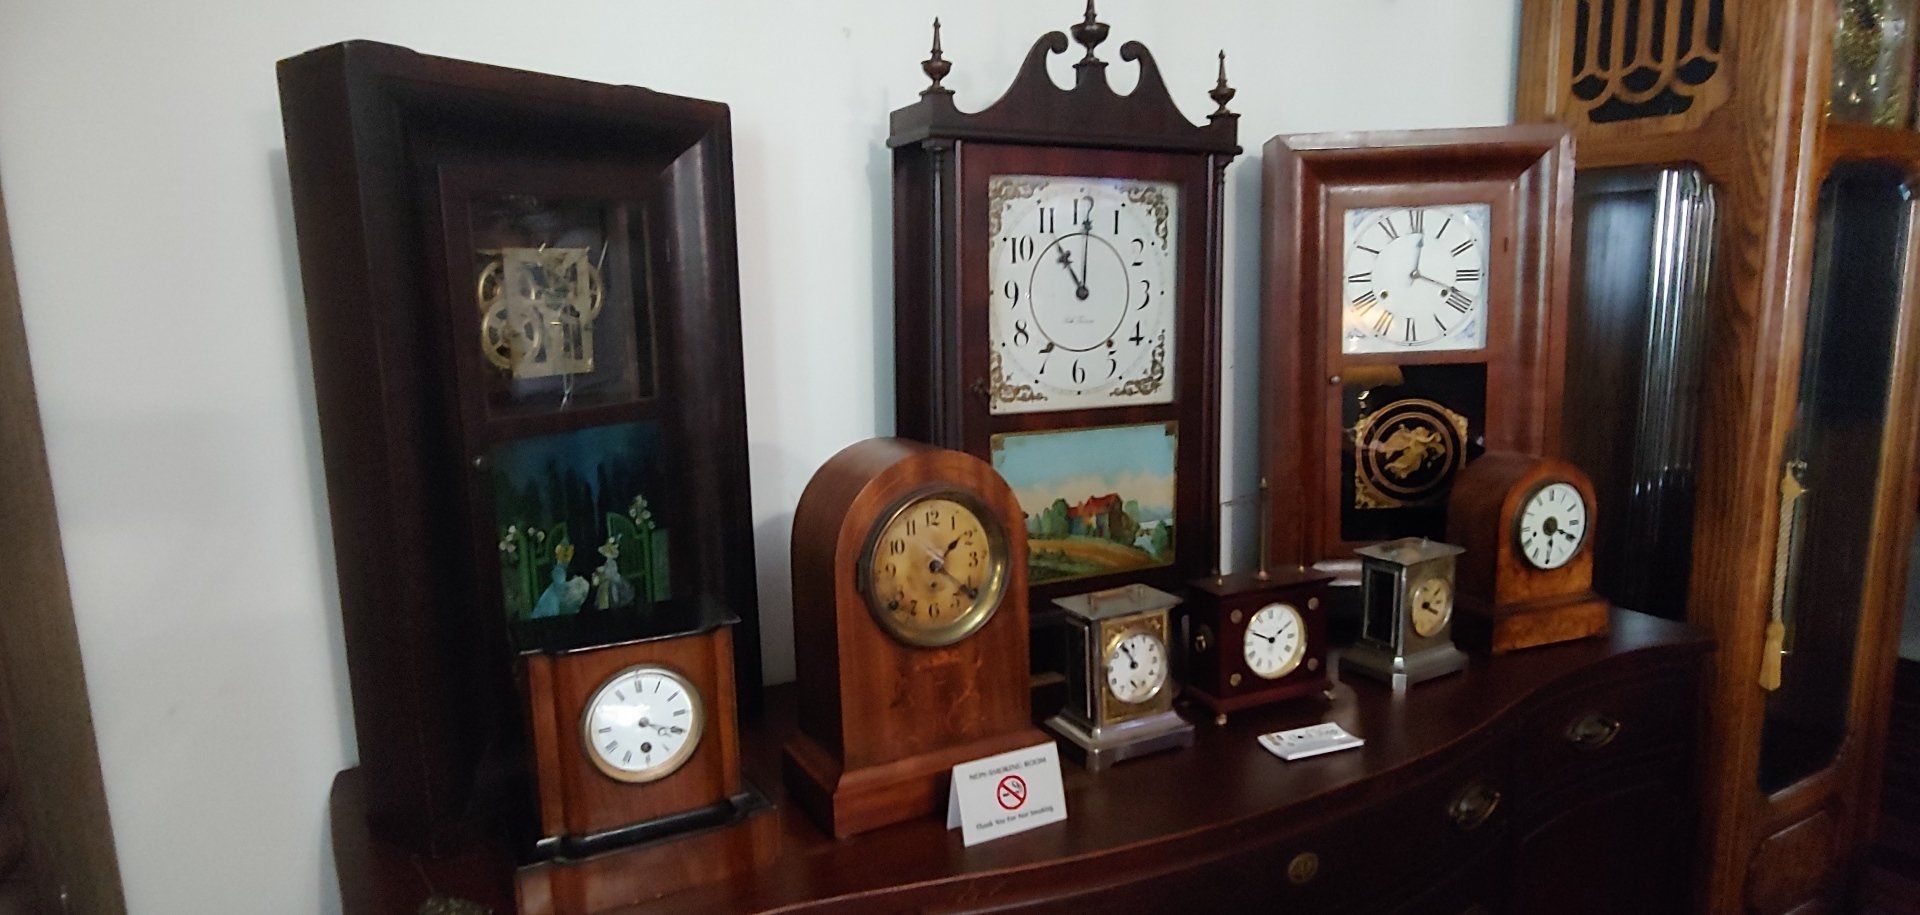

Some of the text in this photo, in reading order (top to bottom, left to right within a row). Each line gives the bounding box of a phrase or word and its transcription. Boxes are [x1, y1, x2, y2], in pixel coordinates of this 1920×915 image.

[1039, 207, 1055, 234] 11
[1113, 209, 1120, 235] 1
[1011, 235, 1034, 264] 10
[1131, 238, 1144, 267] 2
[1004, 280, 1019, 310] 9
[1137, 279, 1150, 311] 3
[1013, 319, 1029, 347] 8
[1128, 320, 1145, 347] 4
[1038, 341, 1055, 375] 7
[1107, 350, 1117, 379] 5
[1072, 359, 1086, 384] 6
[906, 519, 916, 536] 11
[925, 509, 941, 528] 12
[951, 515, 956, 531] 1
[889, 539, 906, 556] 10
[963, 529, 974, 546] 2
[885, 563, 897, 578] 9
[968, 551, 979, 568] 3
[928, 602, 940, 618] 6
